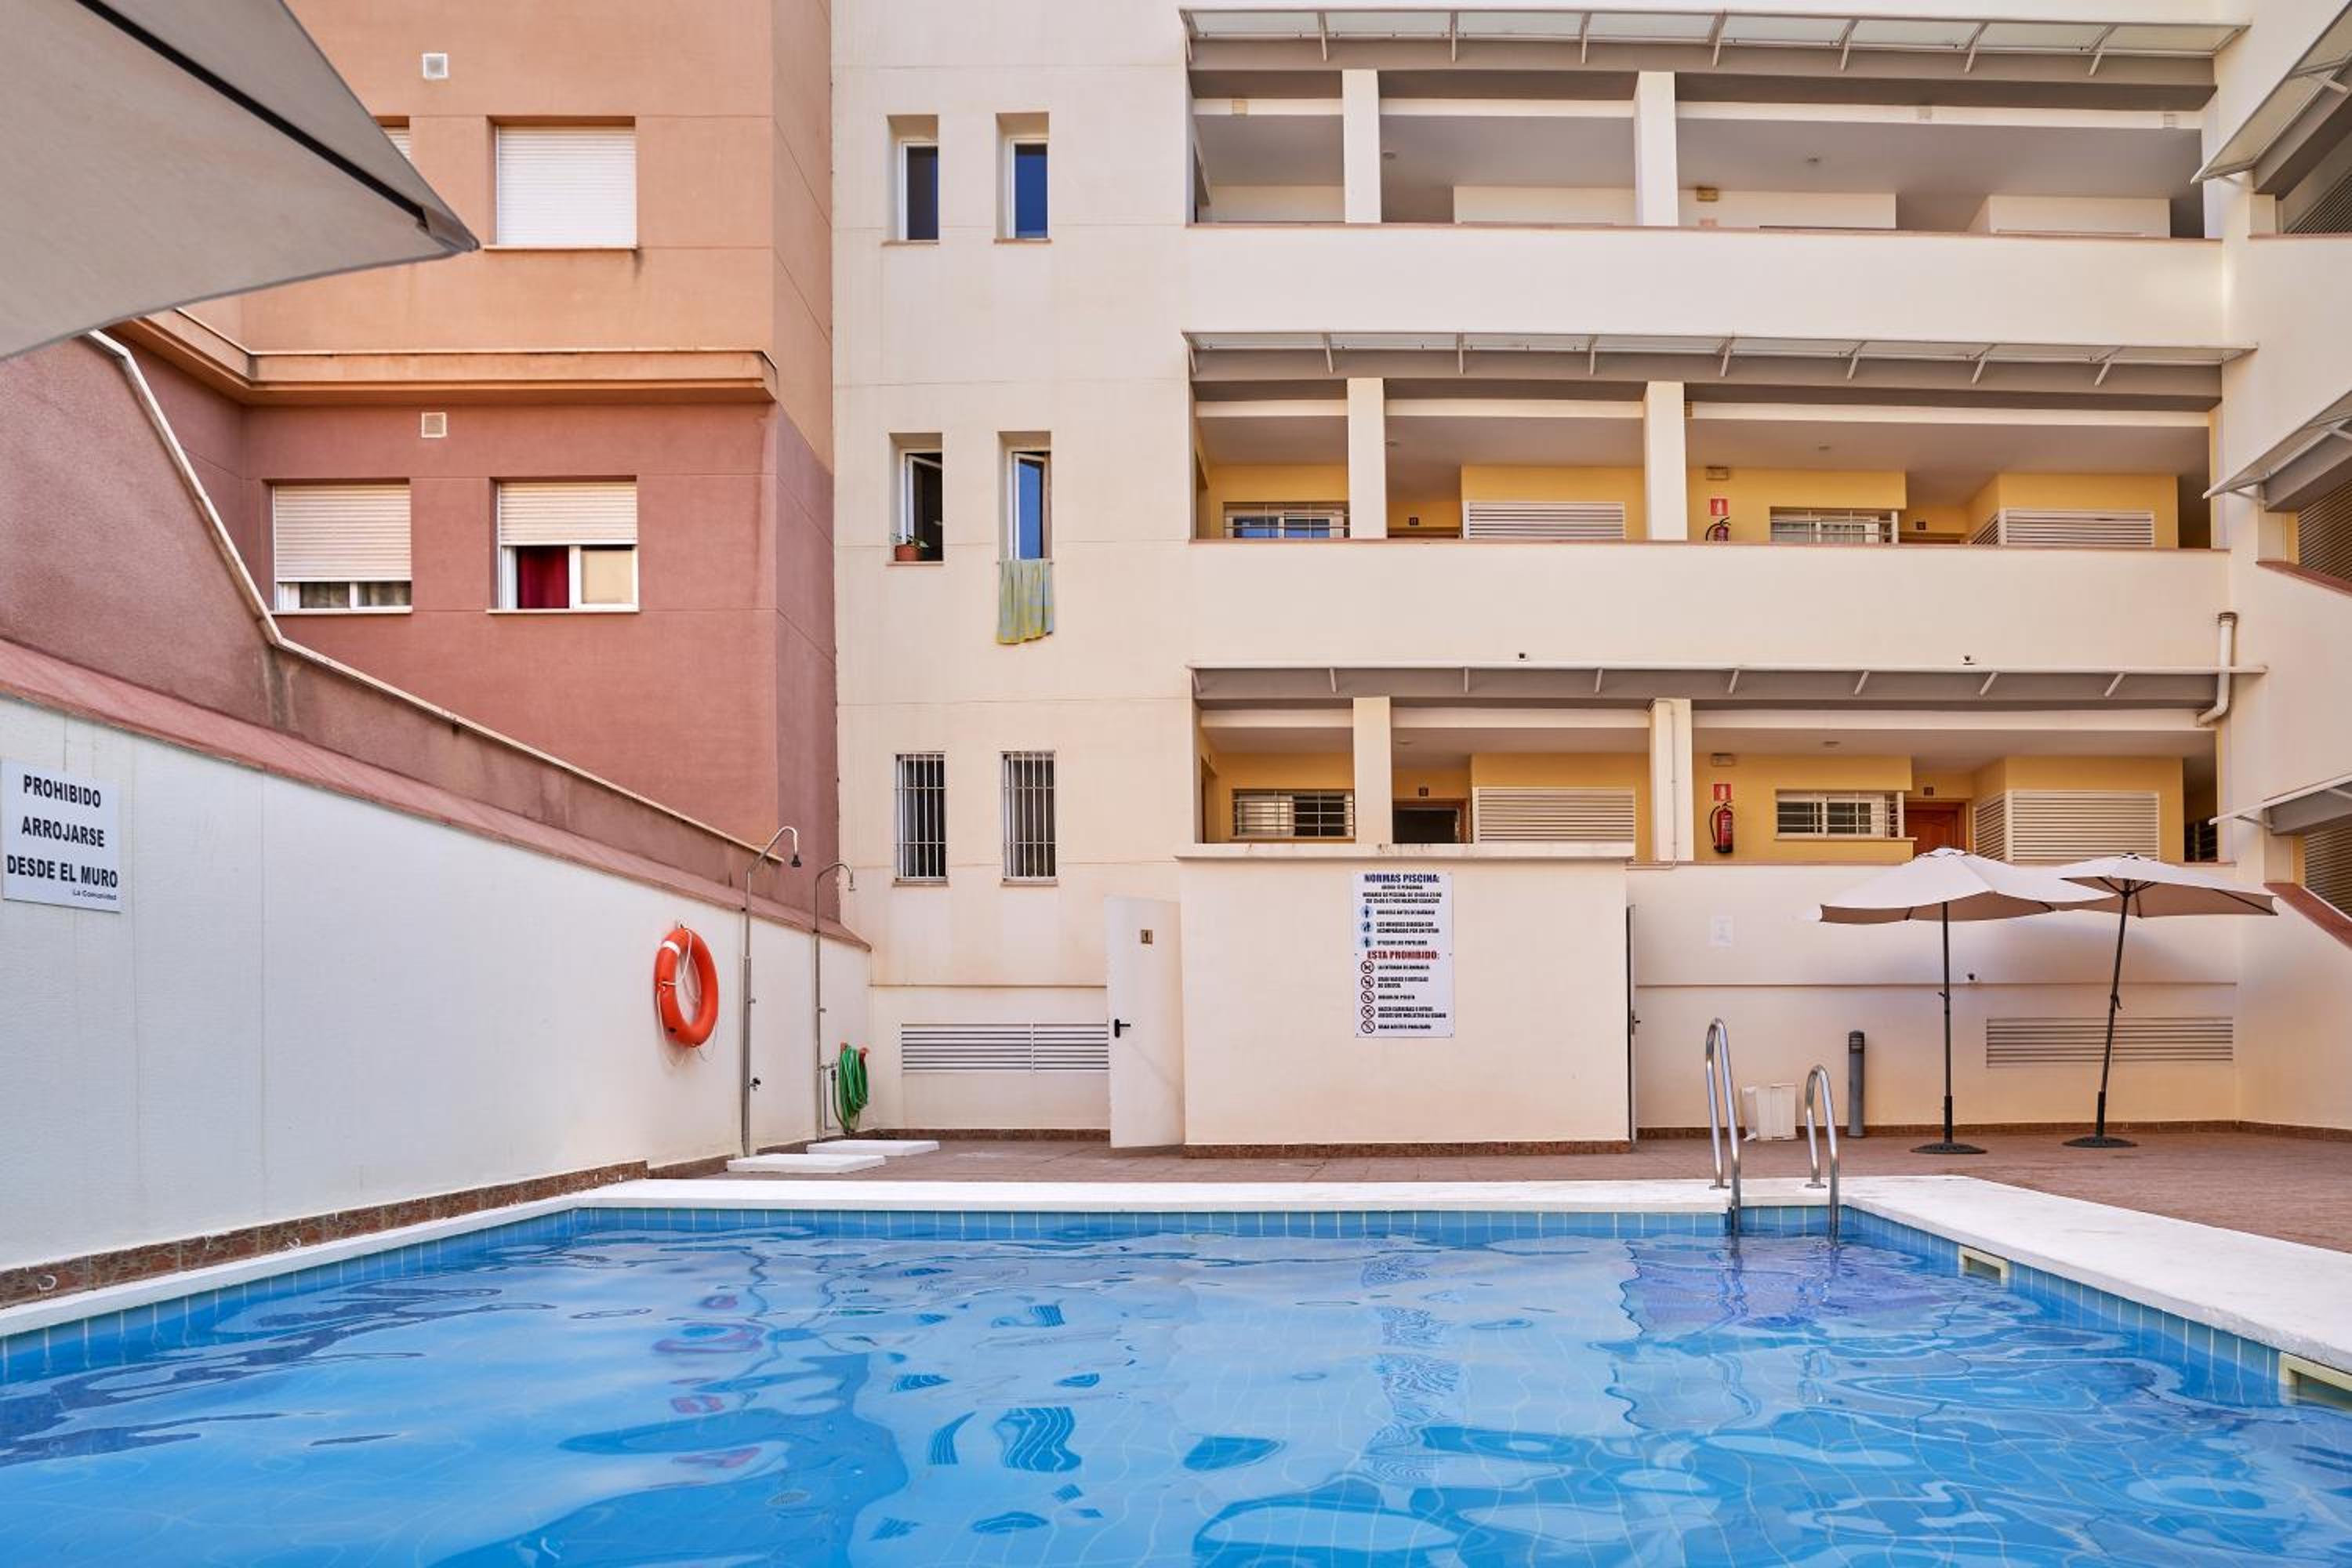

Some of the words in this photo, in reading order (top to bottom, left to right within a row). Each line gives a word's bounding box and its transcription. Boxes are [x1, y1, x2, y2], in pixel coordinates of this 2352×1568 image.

[24, 774, 101, 808] PROHIBIDO
[21, 815, 105, 848] ARROJARSE
[7, 854, 56, 880] DESDE
[60, 862, 77, 883] EL
[81, 865, 118, 888] MURO
[1364, 873, 1401, 883] NORMAS
